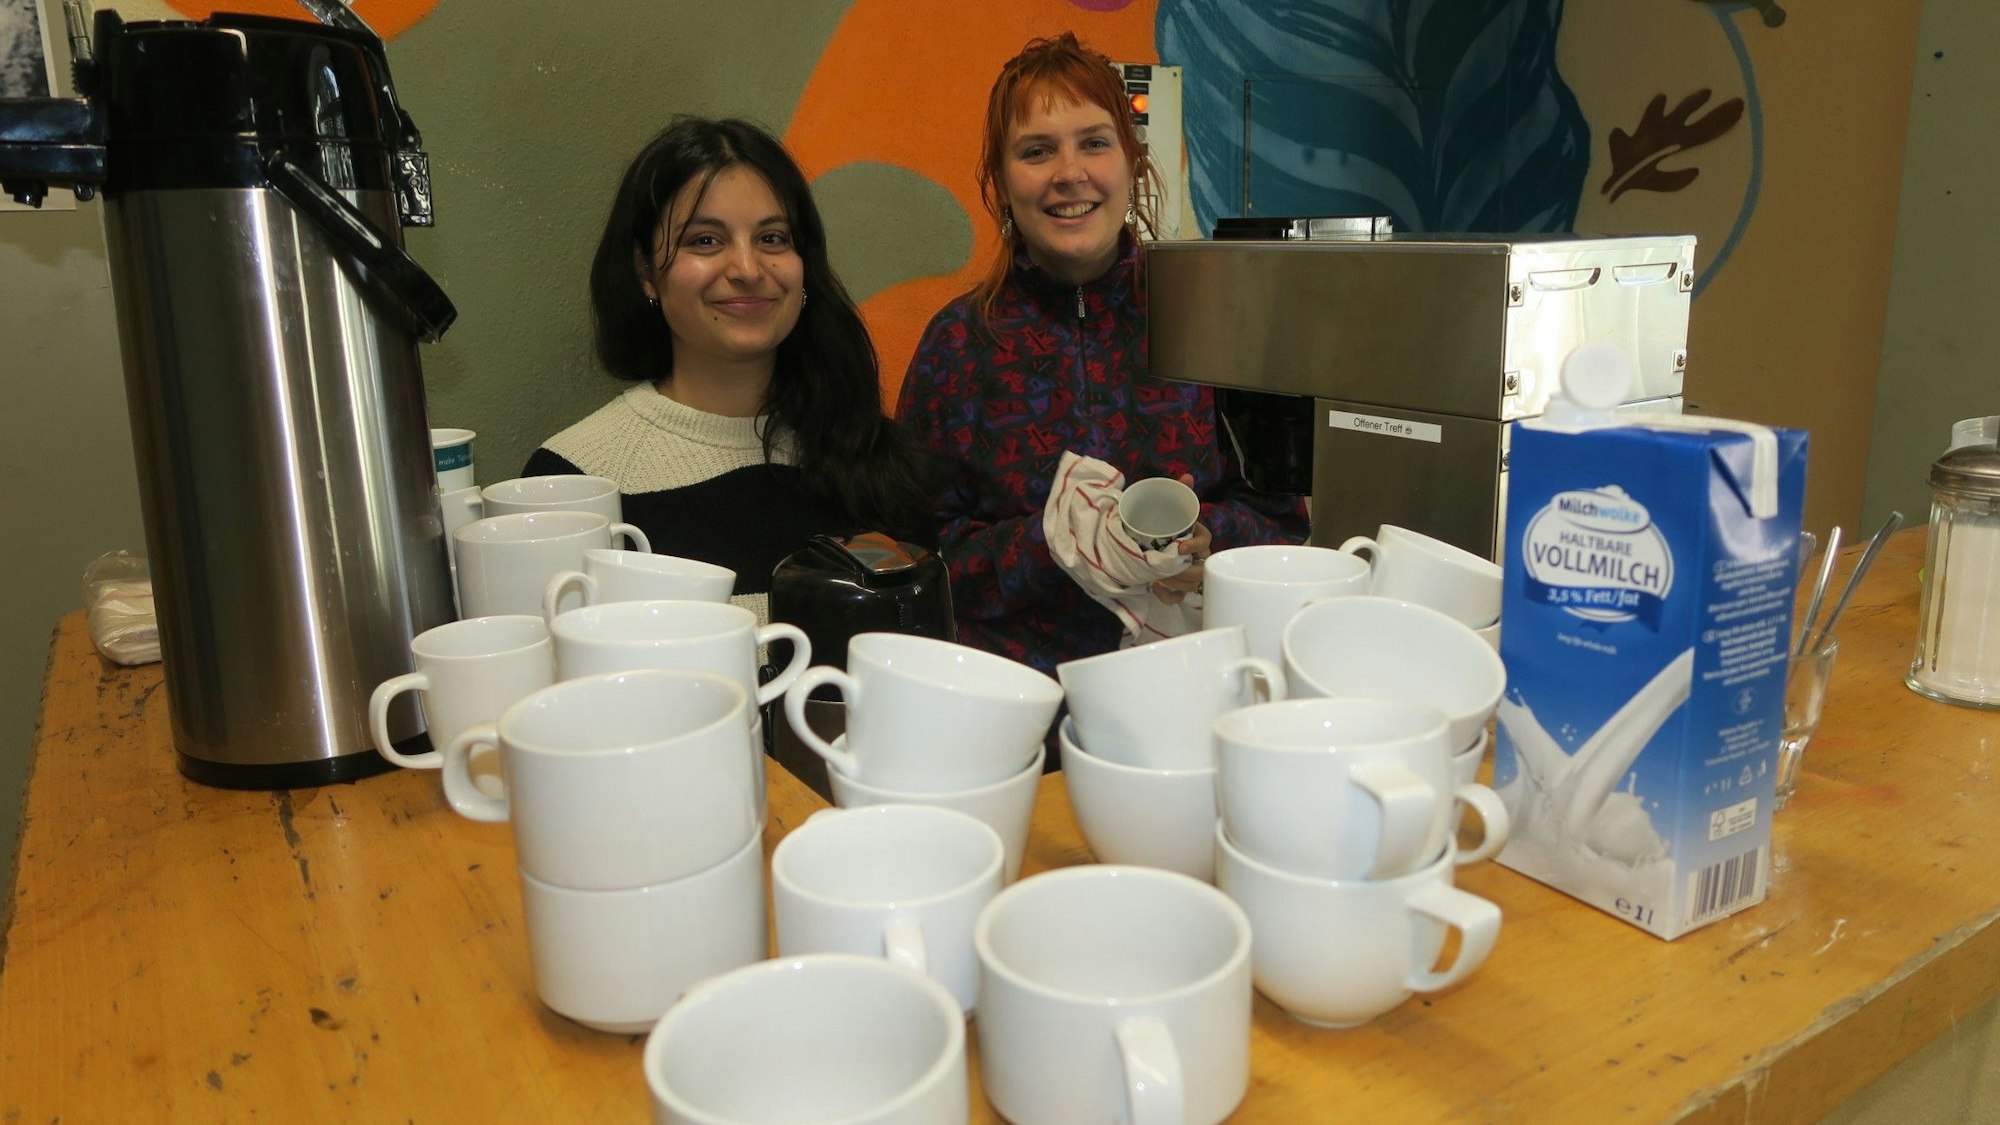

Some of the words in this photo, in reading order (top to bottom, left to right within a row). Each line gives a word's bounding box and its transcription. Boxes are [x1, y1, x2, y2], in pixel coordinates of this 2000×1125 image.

[1353, 417, 1382, 429] Offener
[1384, 421, 1403, 434] Treff
[1559, 498, 1640, 523] Milchwolke
[1559, 531, 1633, 556] HALTBARE
[1533, 542, 1660, 589] VOLLMILCH
